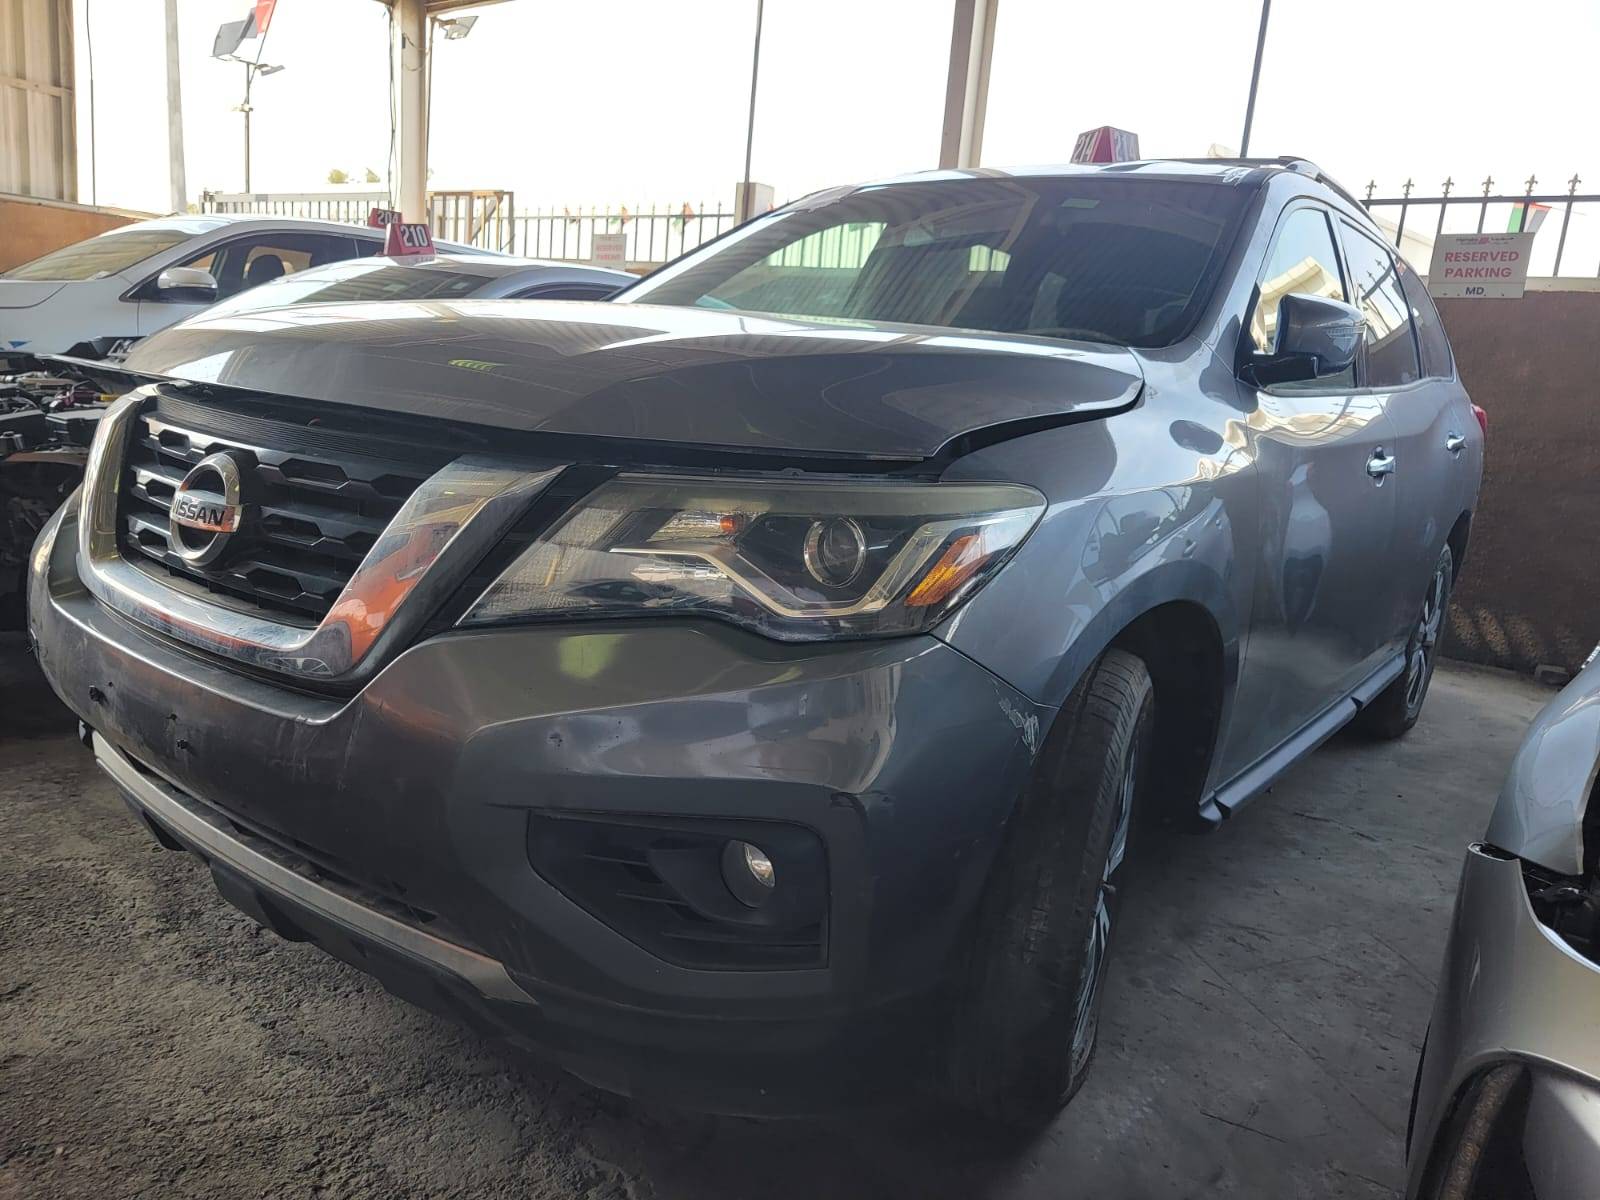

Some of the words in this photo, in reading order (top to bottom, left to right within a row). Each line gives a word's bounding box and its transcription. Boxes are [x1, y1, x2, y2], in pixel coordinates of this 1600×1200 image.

[400, 225, 428, 247] 210
[1444, 251, 1519, 262] RESERVED
[1444, 267, 1512, 278] PARKING
[1465, 286, 1485, 296] MD
